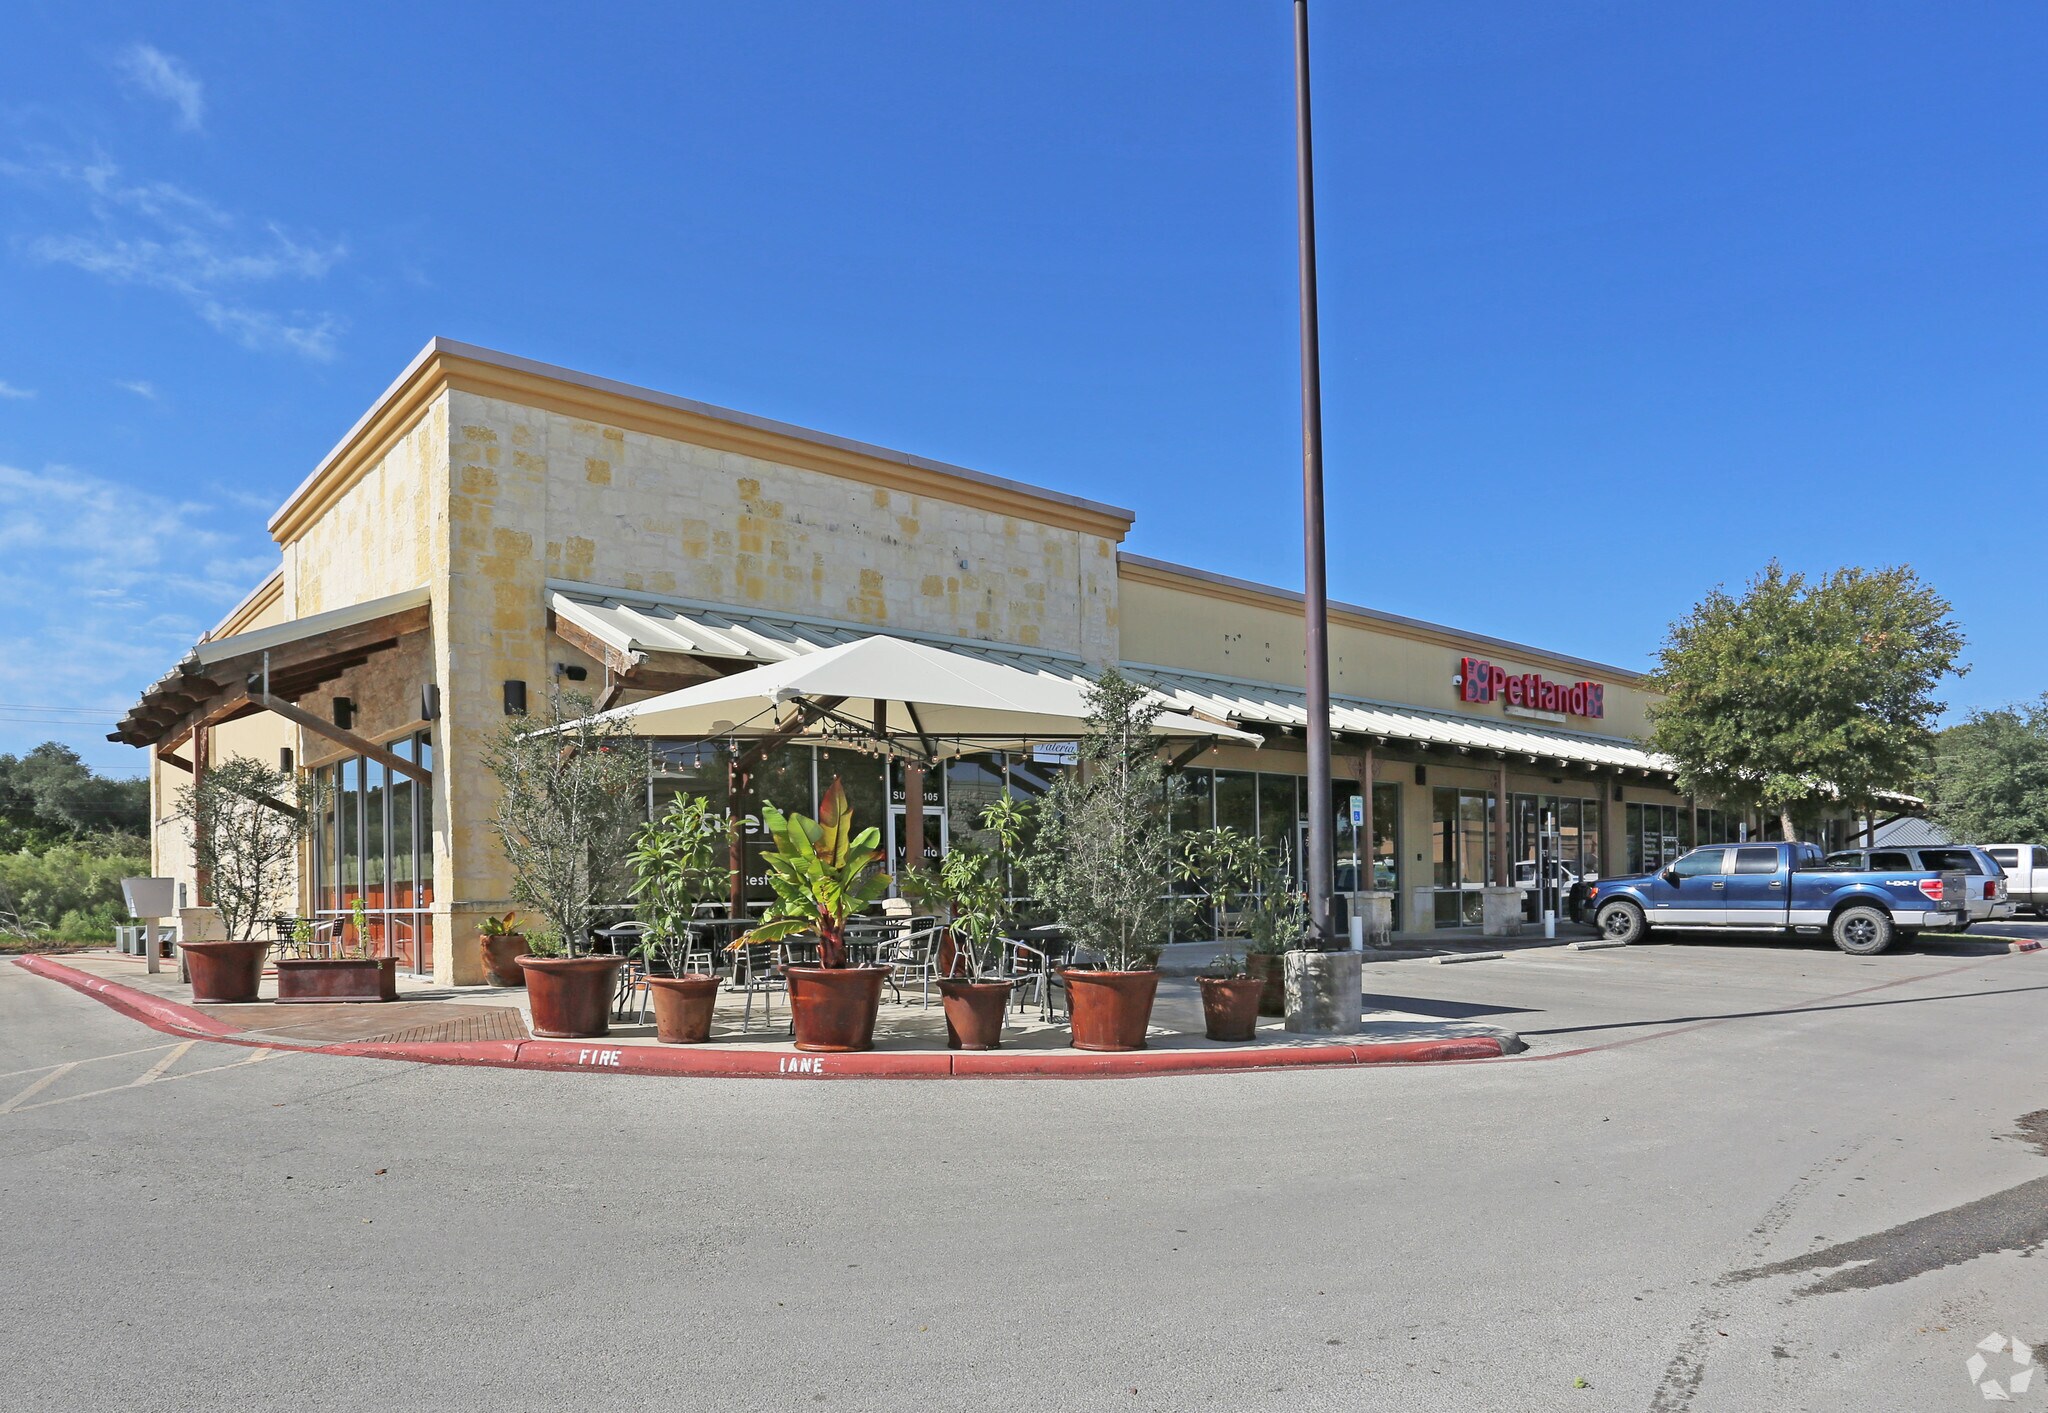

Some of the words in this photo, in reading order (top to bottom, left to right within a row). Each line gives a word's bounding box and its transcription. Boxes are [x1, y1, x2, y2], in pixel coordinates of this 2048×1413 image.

[1489, 666, 1584, 715] Petland
[923, 792, 938, 801] 105
[898, 846, 938, 857] Vria
[578, 1049, 622, 1067] FIRE
[779, 1057, 825, 1073] LANE
